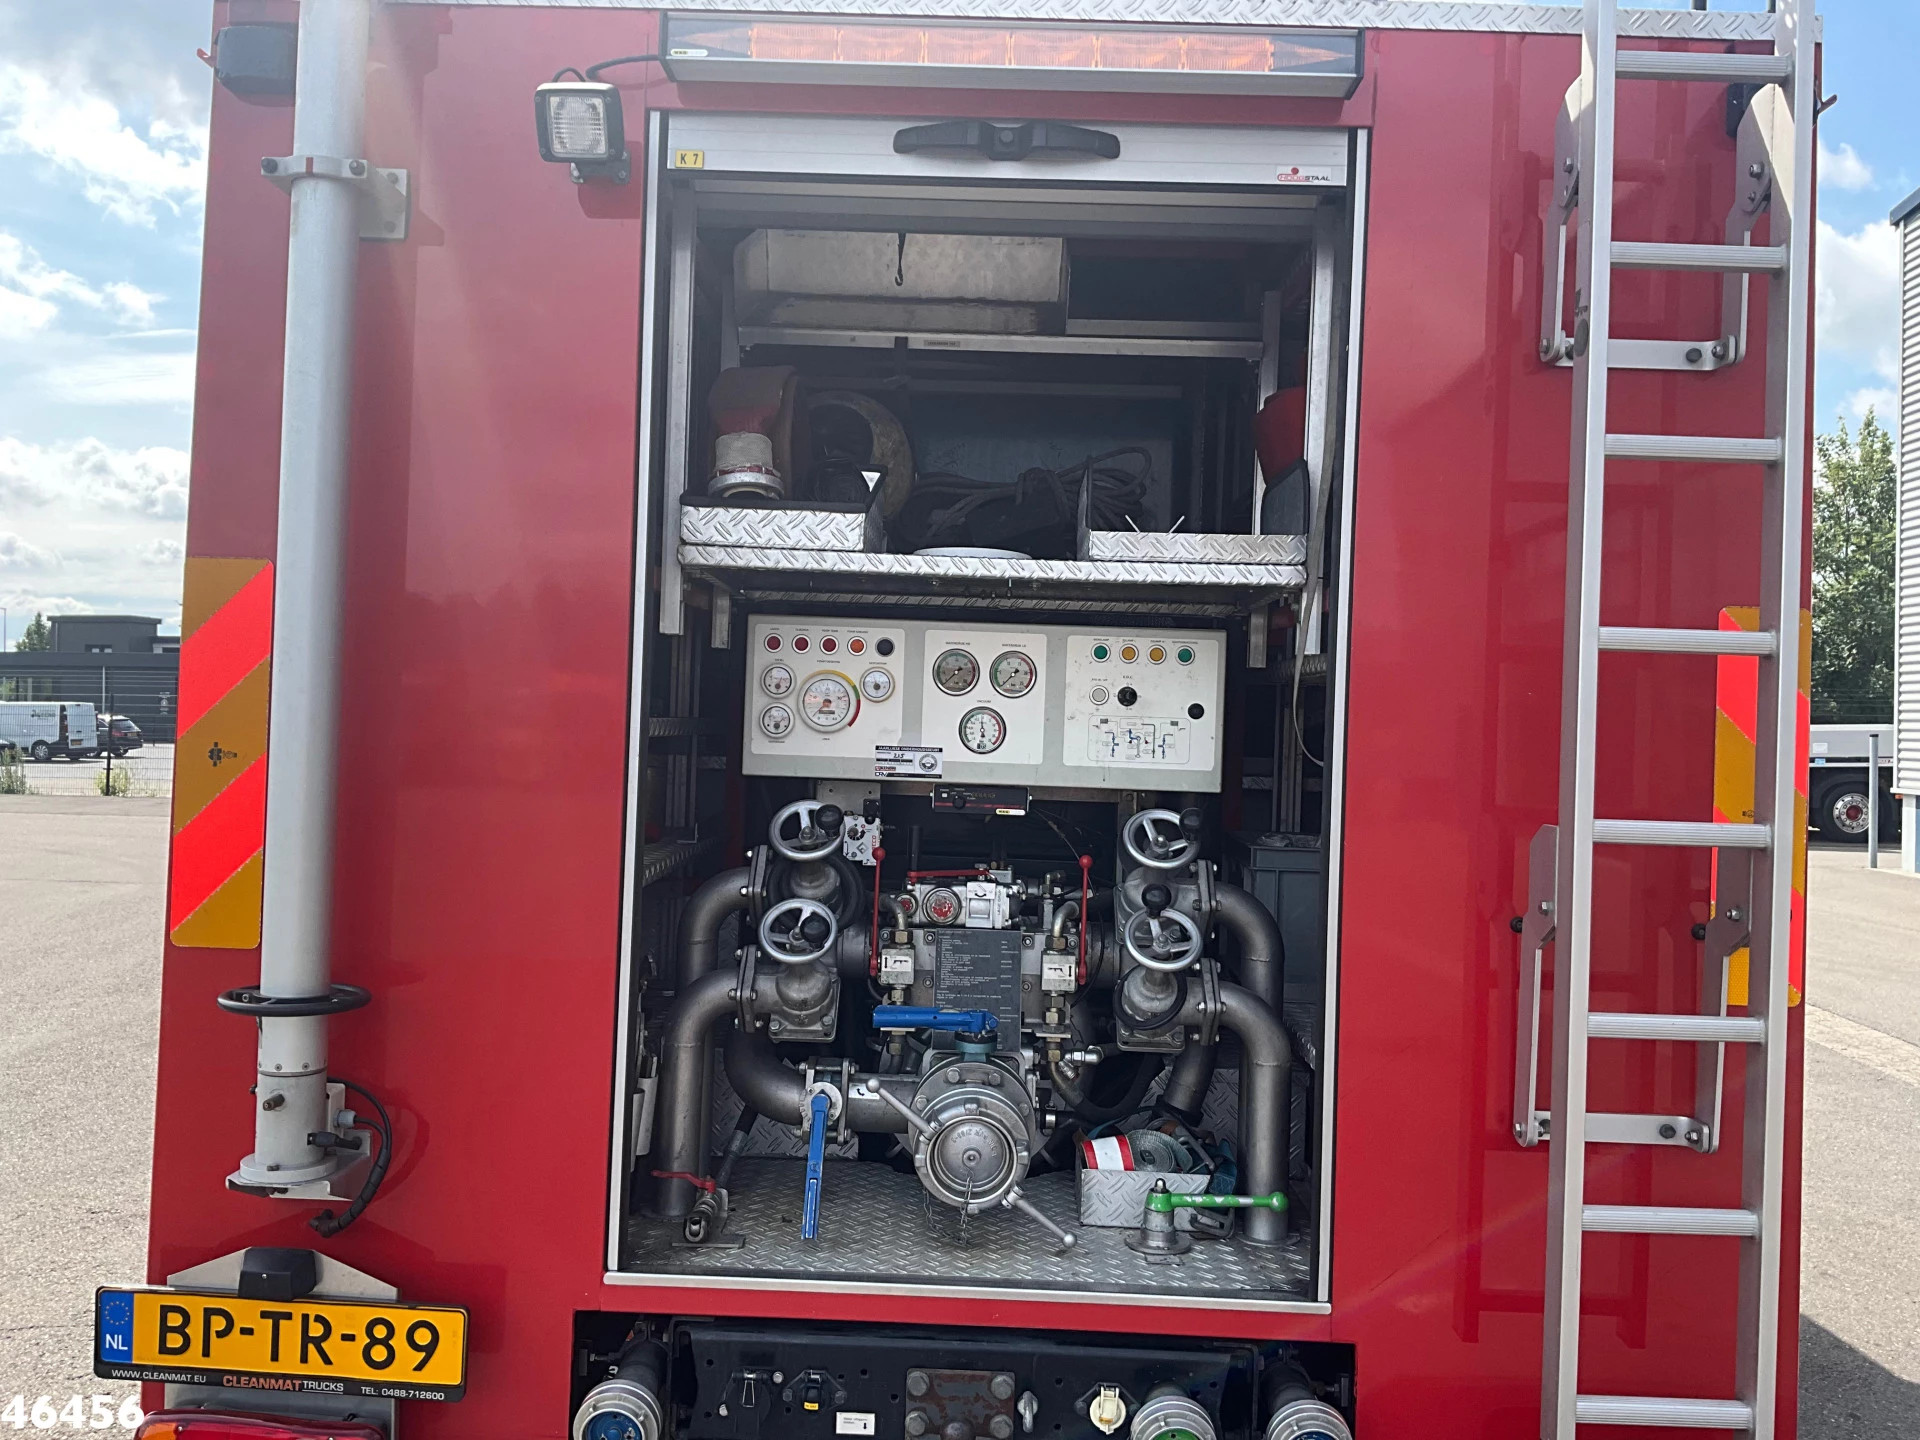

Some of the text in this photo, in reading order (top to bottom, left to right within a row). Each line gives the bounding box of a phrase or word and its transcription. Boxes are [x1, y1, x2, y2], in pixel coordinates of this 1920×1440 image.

[680, 153, 699, 165] K 7
[105, 1333, 128, 1350] NL
[158, 1304, 440, 1372] BP-TR-89
[111, 1369, 445, 1400] WWW.CLEANMAT.EU CLEANMAT TRUCKS TEL: 0488-712600
